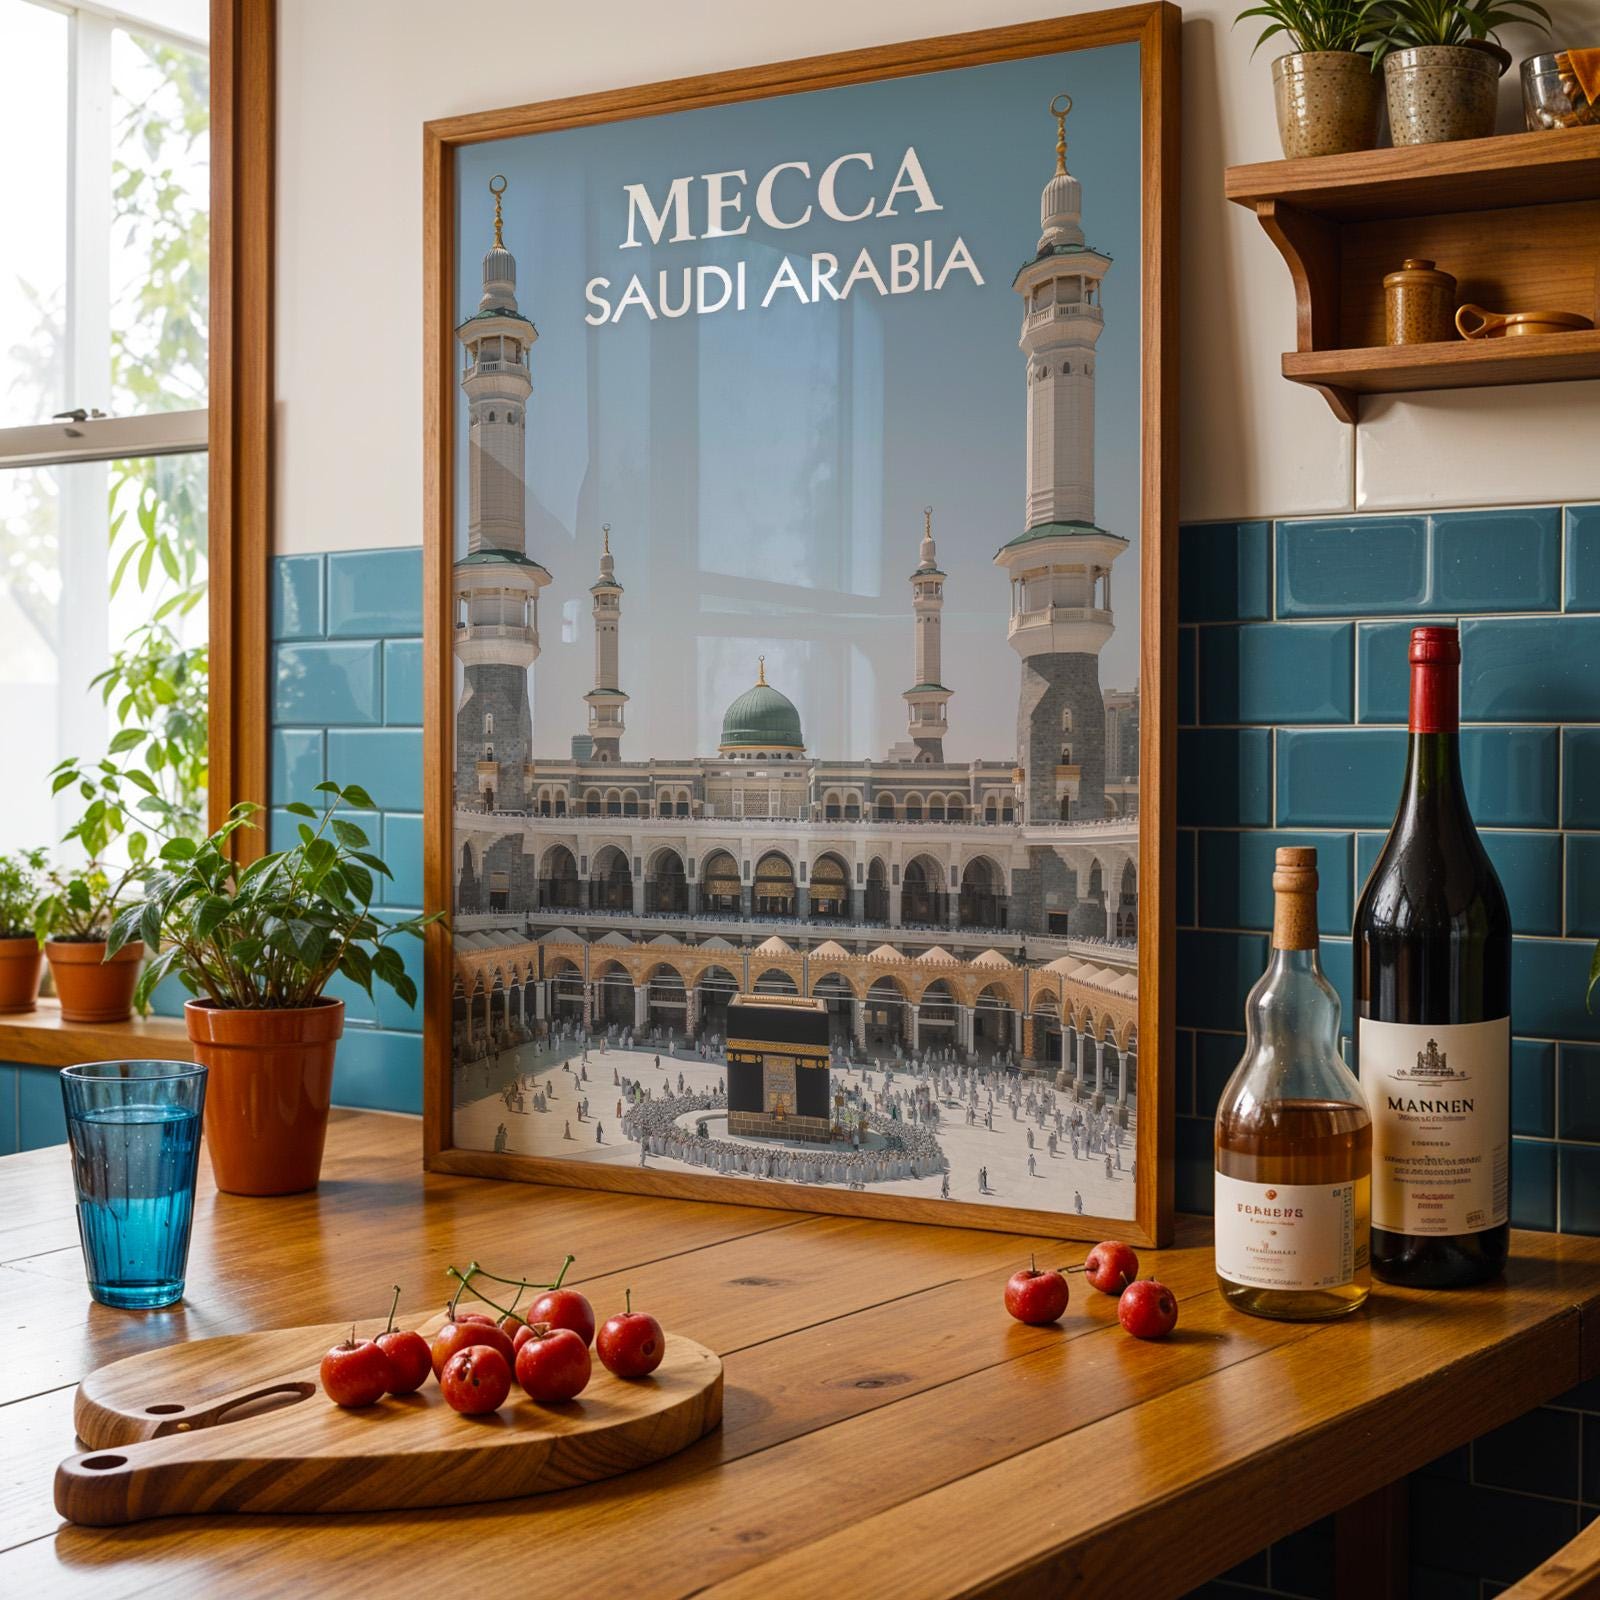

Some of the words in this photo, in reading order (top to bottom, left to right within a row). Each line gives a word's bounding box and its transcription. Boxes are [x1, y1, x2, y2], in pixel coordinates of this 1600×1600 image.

[618, 146, 944, 249] MECCA
[584, 261, 746, 326] SAUDI
[760, 236, 985, 308] ARABIA
[1387, 1096, 1475, 1113] MANNEN
